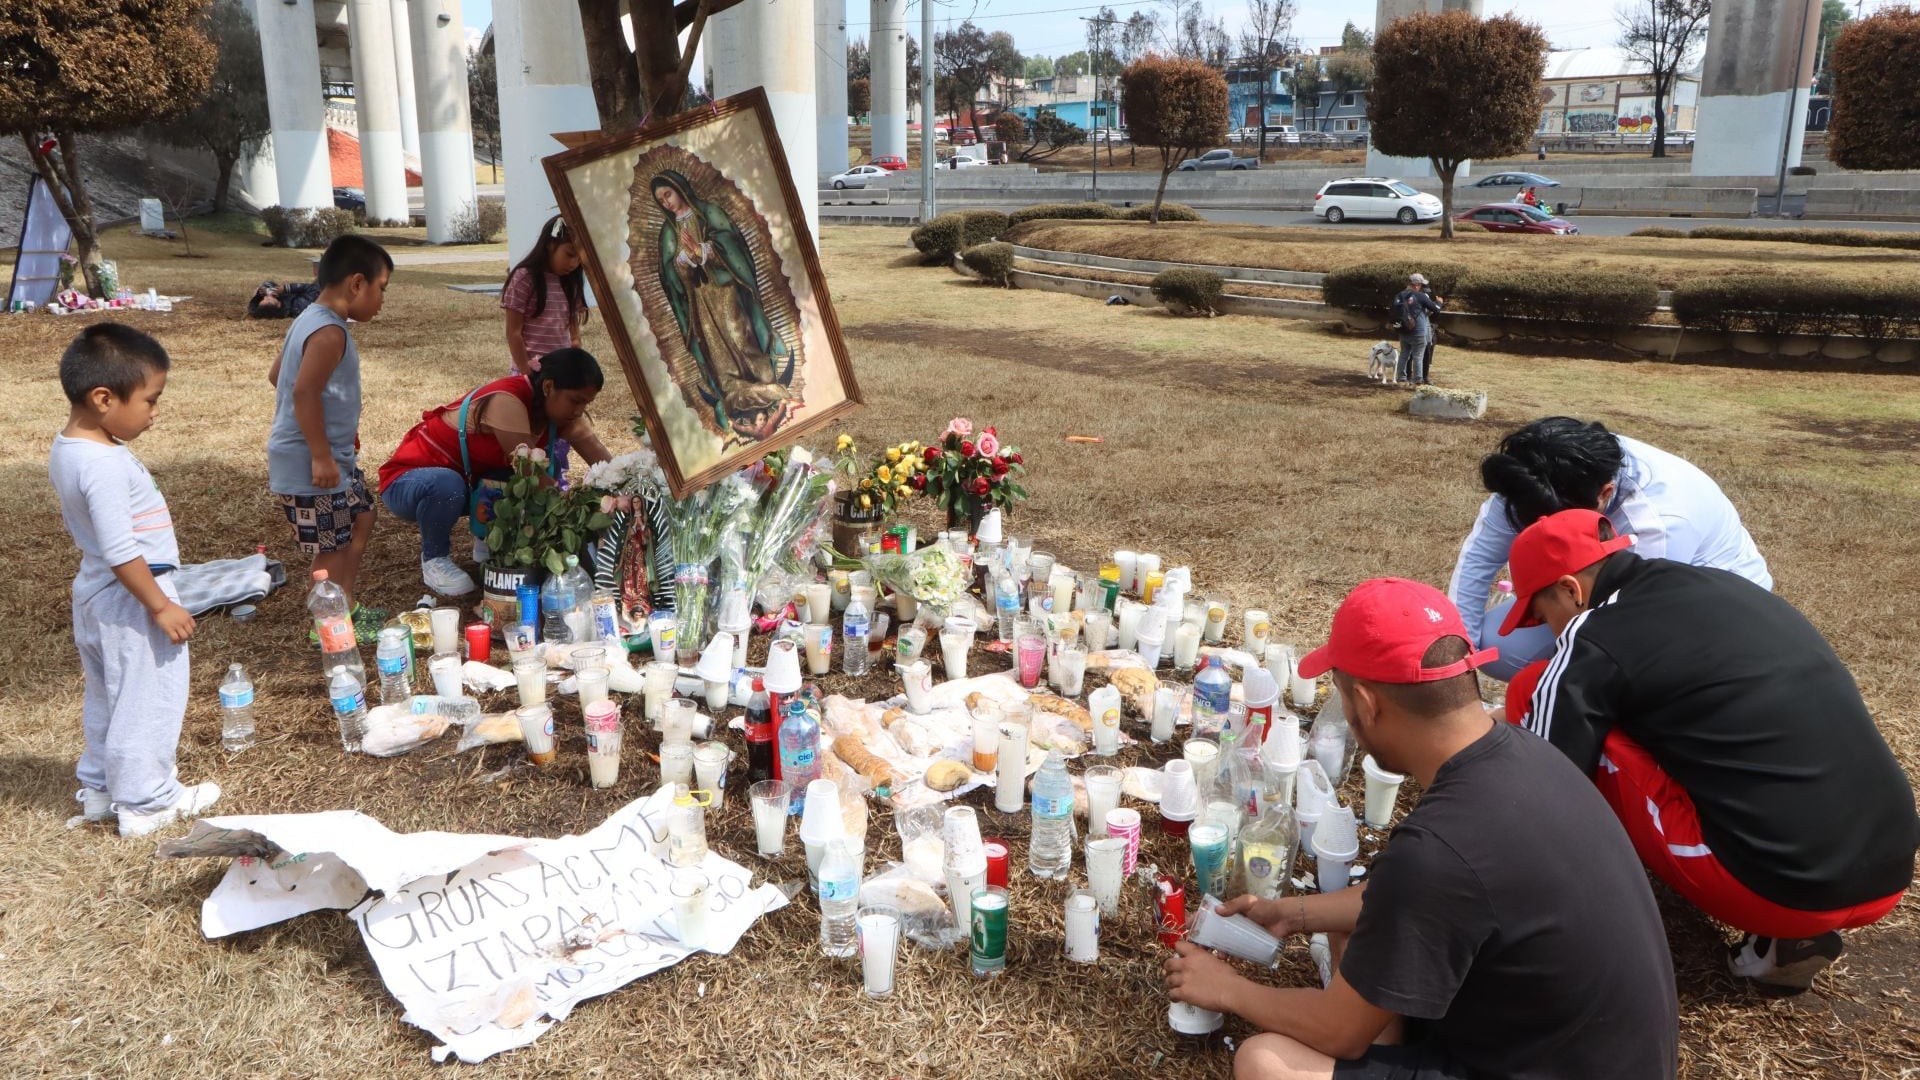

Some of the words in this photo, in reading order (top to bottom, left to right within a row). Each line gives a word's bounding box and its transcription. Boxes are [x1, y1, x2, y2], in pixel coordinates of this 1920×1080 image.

[1423, 607, 1444, 622] LA
[798, 751, 814, 761] ciel
[362, 872, 530, 949] GRUAS
[540, 806, 670, 898] ACME
